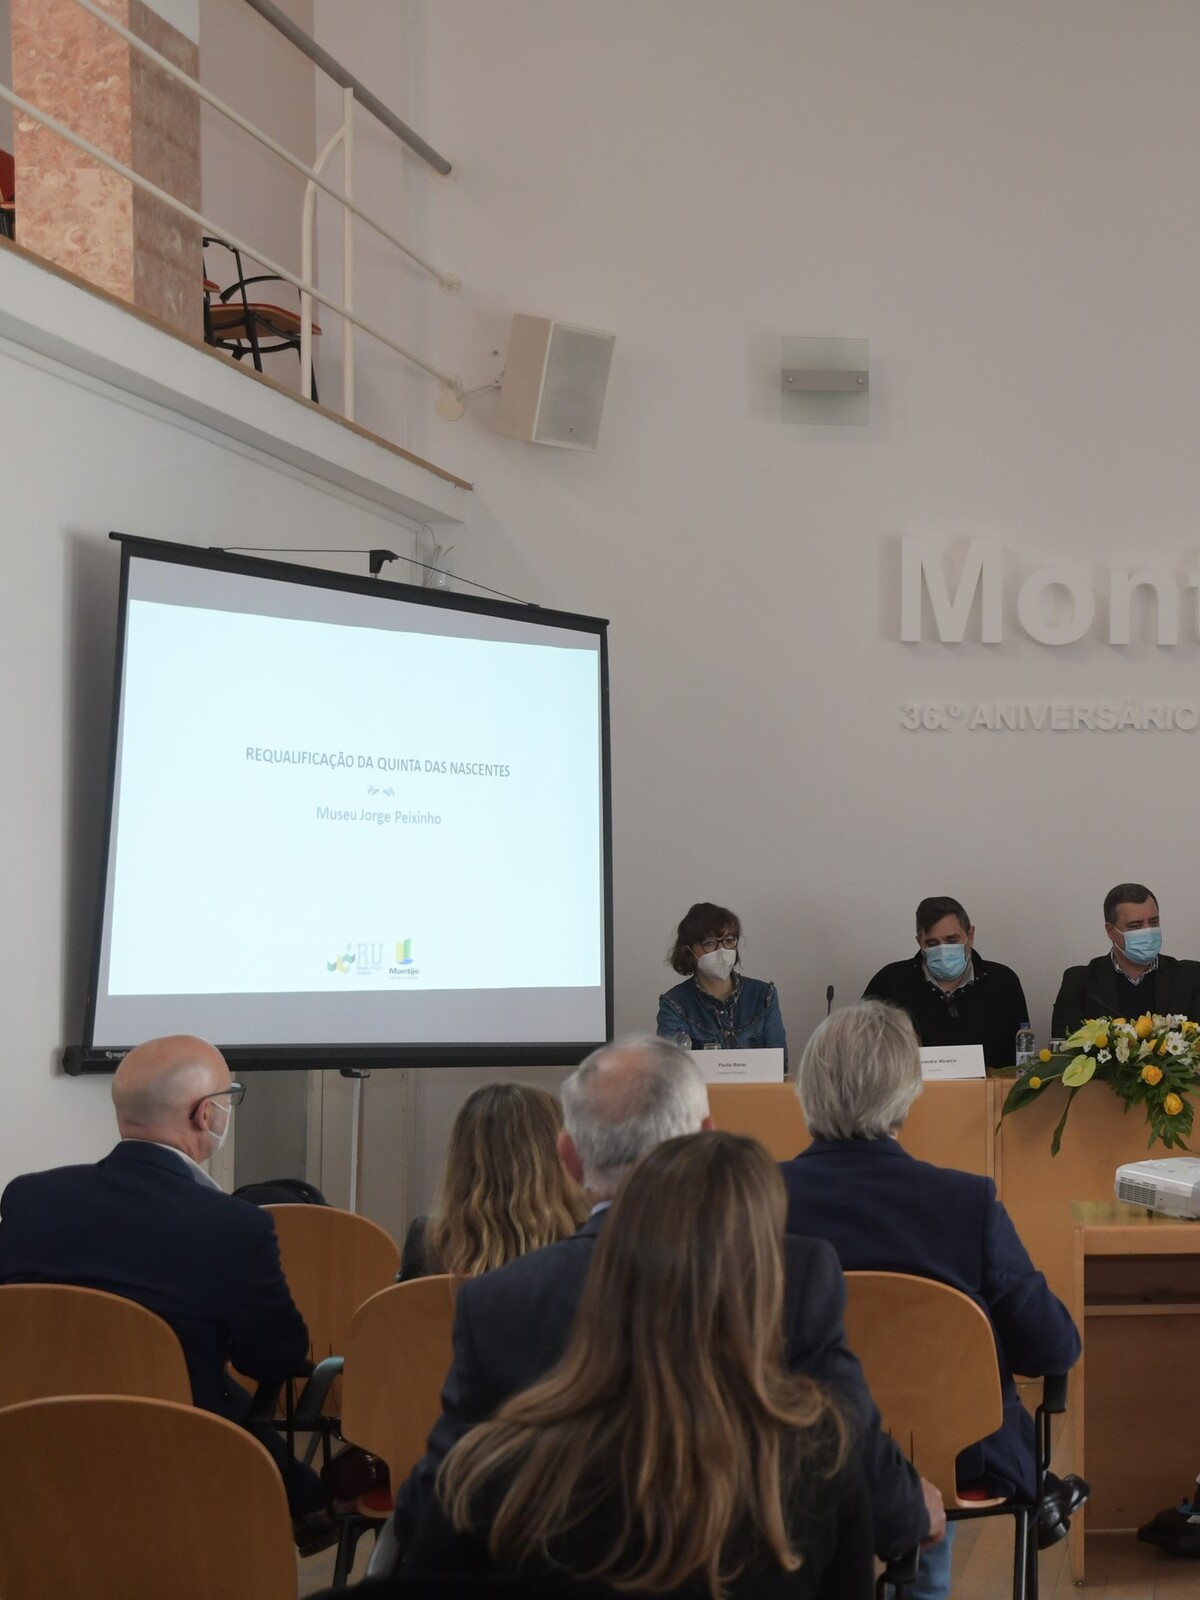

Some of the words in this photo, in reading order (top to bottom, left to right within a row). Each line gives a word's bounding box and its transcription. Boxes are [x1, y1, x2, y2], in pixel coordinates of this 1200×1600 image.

[969, 701, 1200, 732] ANIVERSÁRIO
[245, 746, 355, 770] REQUALIFICAÇÃO
[357, 755, 374, 769] DA
[377, 757, 422, 773] QUINTA
[424, 760, 447, 774] DAS
[450, 761, 511, 778] NASCENTES
[315, 805, 358, 822] Museu
[359, 807, 392, 826] Jorge
[395, 810, 442, 825] Peixinho
[388, 967, 420, 976] Montijo
